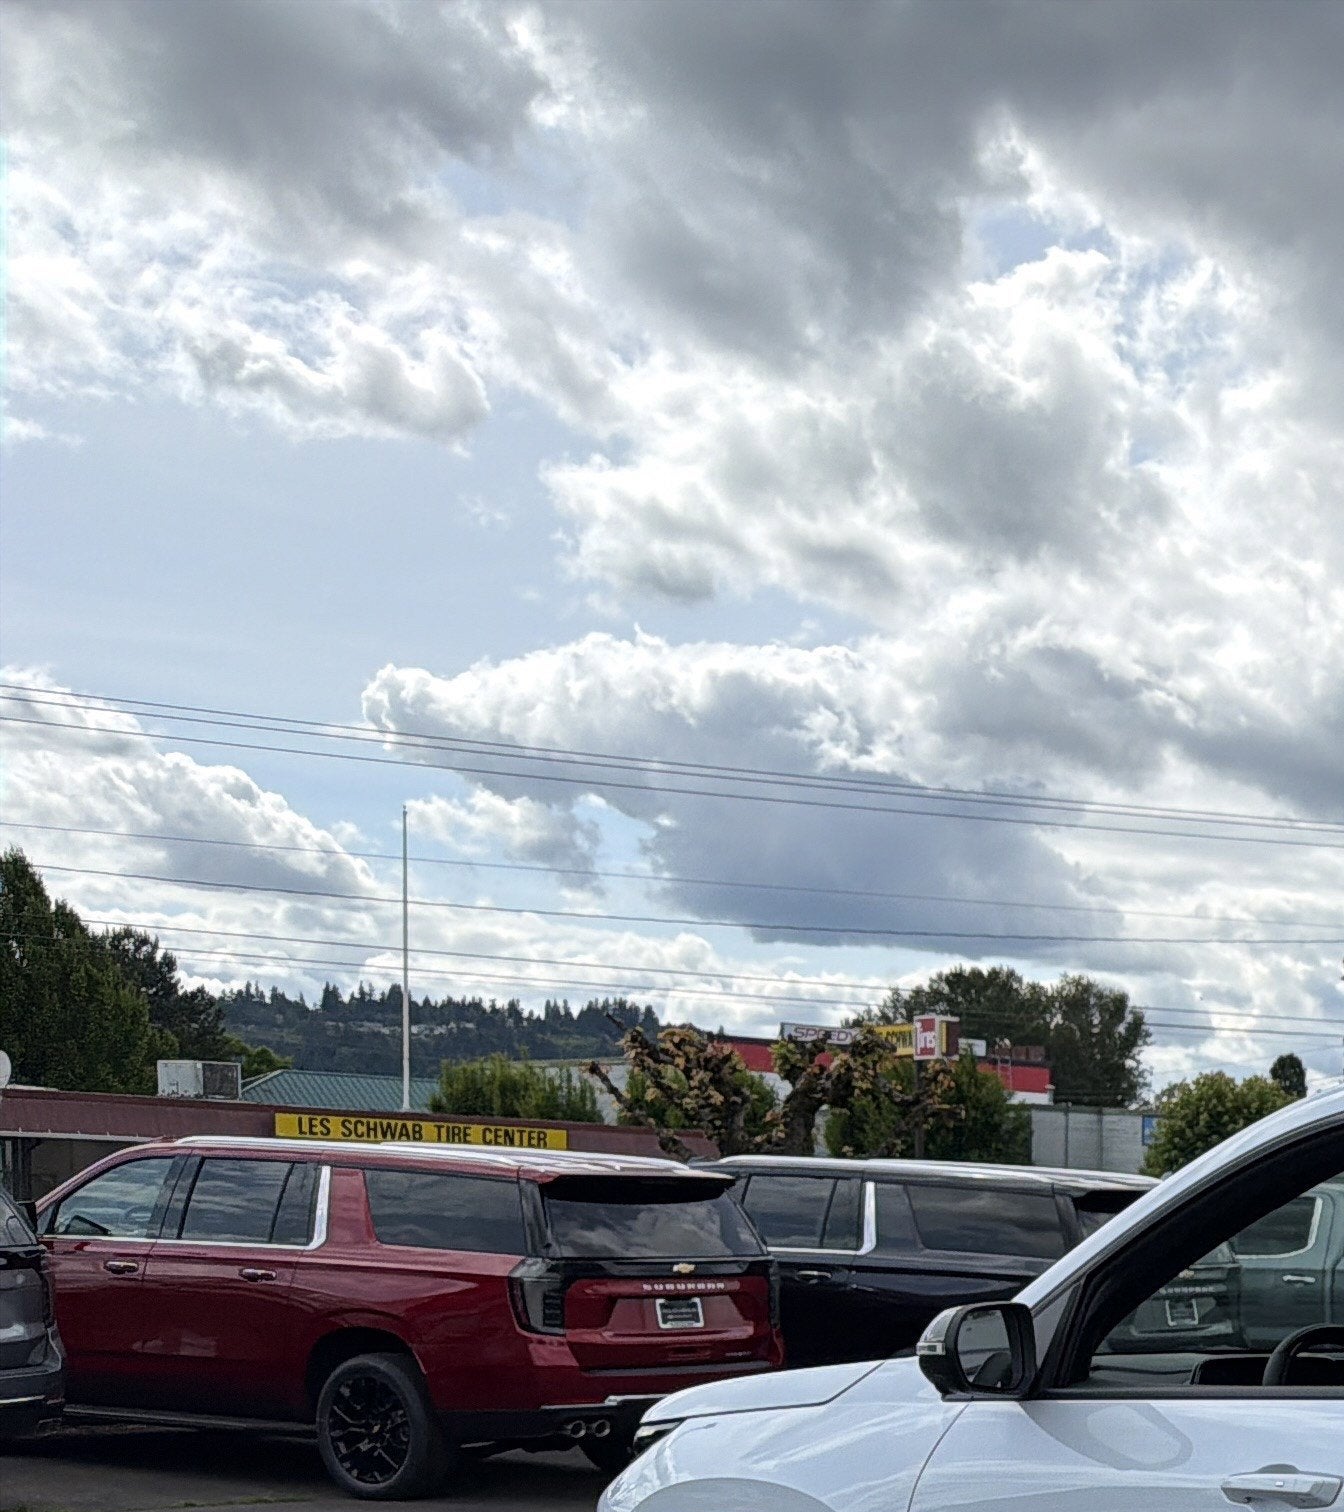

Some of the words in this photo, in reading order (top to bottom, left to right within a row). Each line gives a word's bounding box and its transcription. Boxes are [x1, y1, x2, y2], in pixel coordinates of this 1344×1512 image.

[297, 1116, 331, 1136] LES
[341, 1119, 423, 1142] SCHWAB
[434, 1123, 471, 1144] TIRE
[481, 1127, 548, 1149] CENTER
